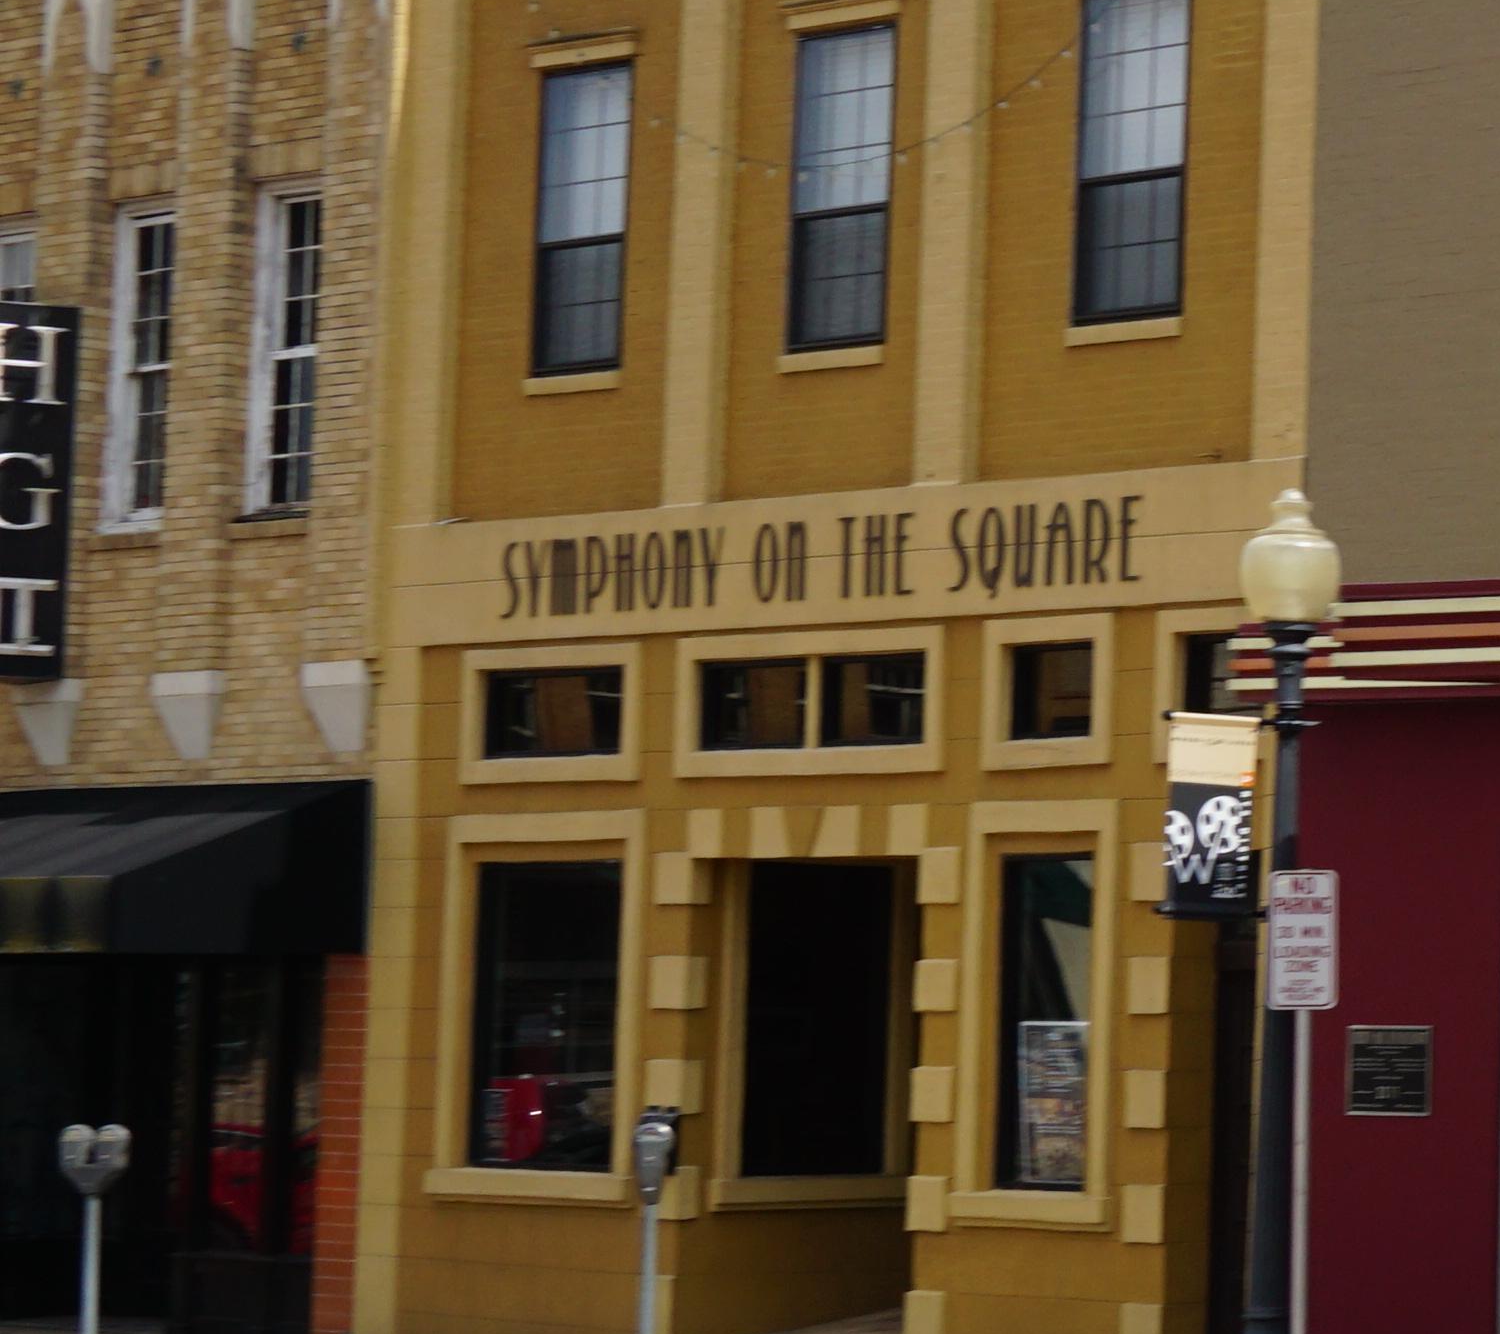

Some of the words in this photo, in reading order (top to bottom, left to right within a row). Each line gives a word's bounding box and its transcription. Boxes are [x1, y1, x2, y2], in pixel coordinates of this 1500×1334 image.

[500, 526, 725, 620] SYMPHONY
[753, 521, 806, 603] ON
[837, 512, 916, 599] THE
[946, 495, 1143, 599] SQUARE
[1273, 896, 1332, 915] PARKING
